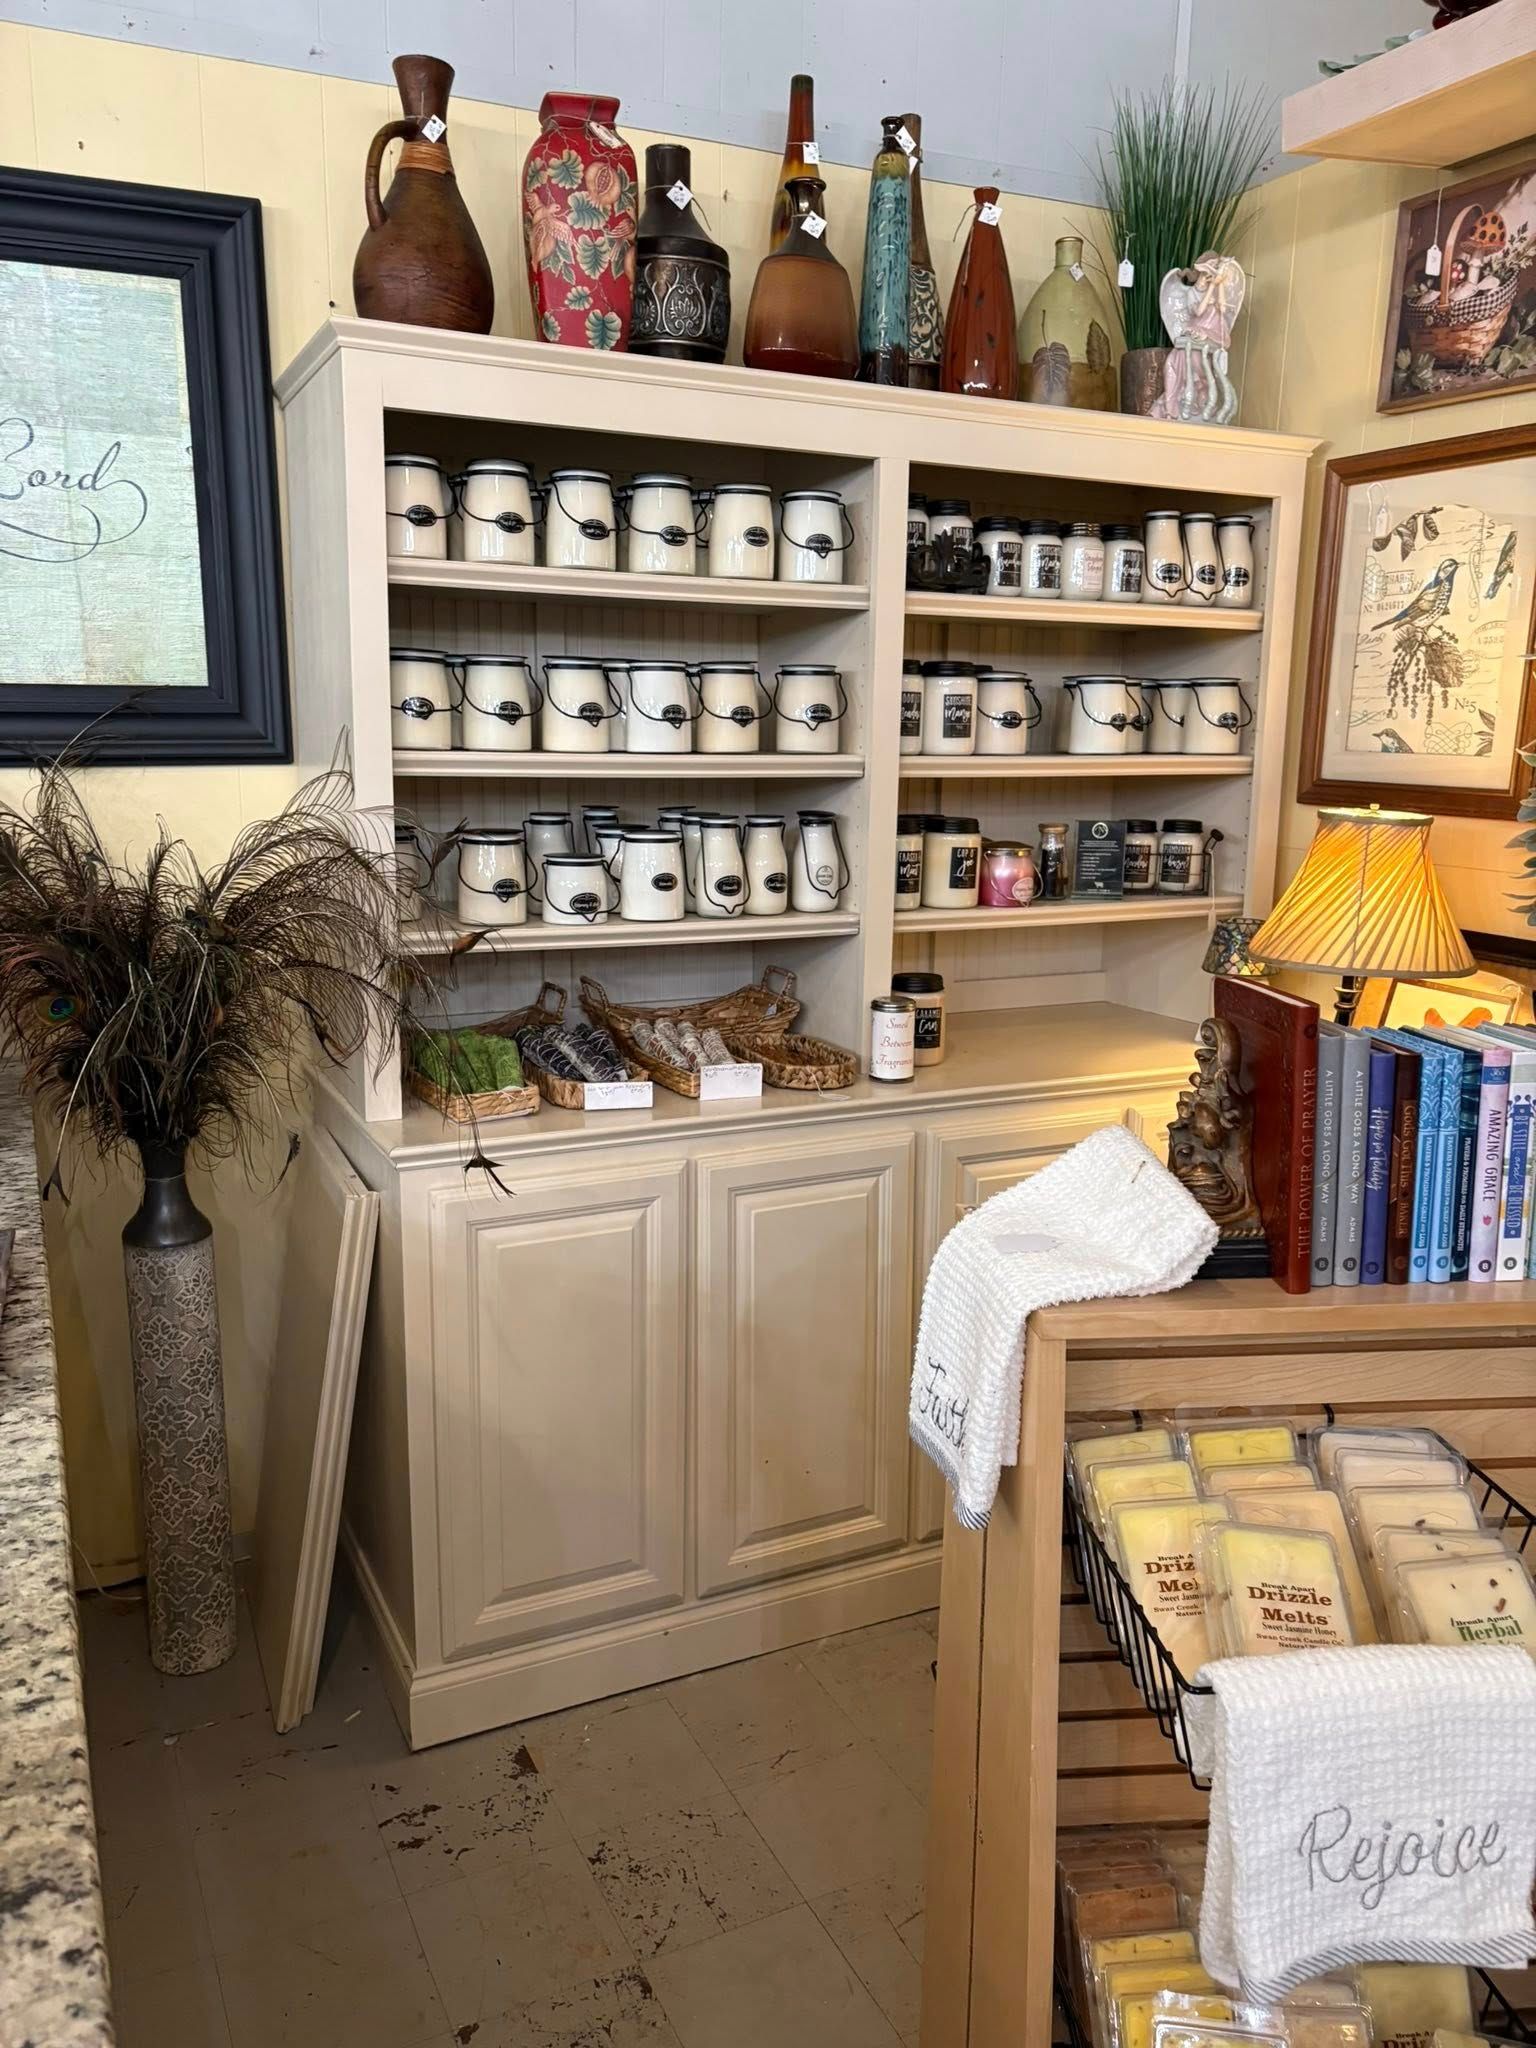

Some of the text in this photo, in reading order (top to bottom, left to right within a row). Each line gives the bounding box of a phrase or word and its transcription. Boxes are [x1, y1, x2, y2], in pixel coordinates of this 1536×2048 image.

[1325, 1069, 1334, 1077] A
[1324, 1080, 1334, 1107] LITTLE
[1354, 1080, 1363, 1107] LITTLE
[1323, 1110, 1333, 1137] GOES
[1353, 1110, 1362, 1137] GOES
[1369, 1107, 1389, 1140] Hope
[1463, 1137, 1471, 1161] PRAYERS
[1482, 1109, 1502, 1202] AMAZING GRACE
[1297, 1067, 1316, 1259] THE POWER OF PRAYER
[1321, 1150, 1331, 1178] LONG
[1351, 1150, 1361, 1178] LONG
[1366, 1152, 1388, 1191] Today
[1400, 1158, 1412, 1188] This
[1506, 1115, 1529, 1228] BE STILL and BE BLESSED
[1321, 1182, 1330, 1205] WAY
[1350, 1182, 1359, 1205] WAY
[1461, 1166, 1469, 1195] PROMISES
[1458, 1204, 1466, 1221] DAILY
[1320, 1216, 1328, 1242] ADAMS
[1348, 1216, 1357, 1243] ADAMS
[1456, 1221, 1465, 1252] STRENGTH
[1143, 1560, 1196, 1575] Driz
[1158, 1593, 1200, 1603] Sweet Jasm
[1246, 1585, 1332, 1606] Drizzle
[1261, 1582, 1316, 1593] Break Apart
[1176, 1603, 1199, 1611] Creek
[1260, 1606, 1329, 1626] Melts
[1455, 1614, 1514, 1626] Break Apart
[1261, 1621, 1337, 1638] Sweet Jasmine Honey
[1279, 1635, 1302, 1643] Creek
[1303, 1637, 1330, 1645] Candle
[1457, 1620, 1523, 1642] Herbal
[1299, 1804, 1506, 1911] Rejoice
